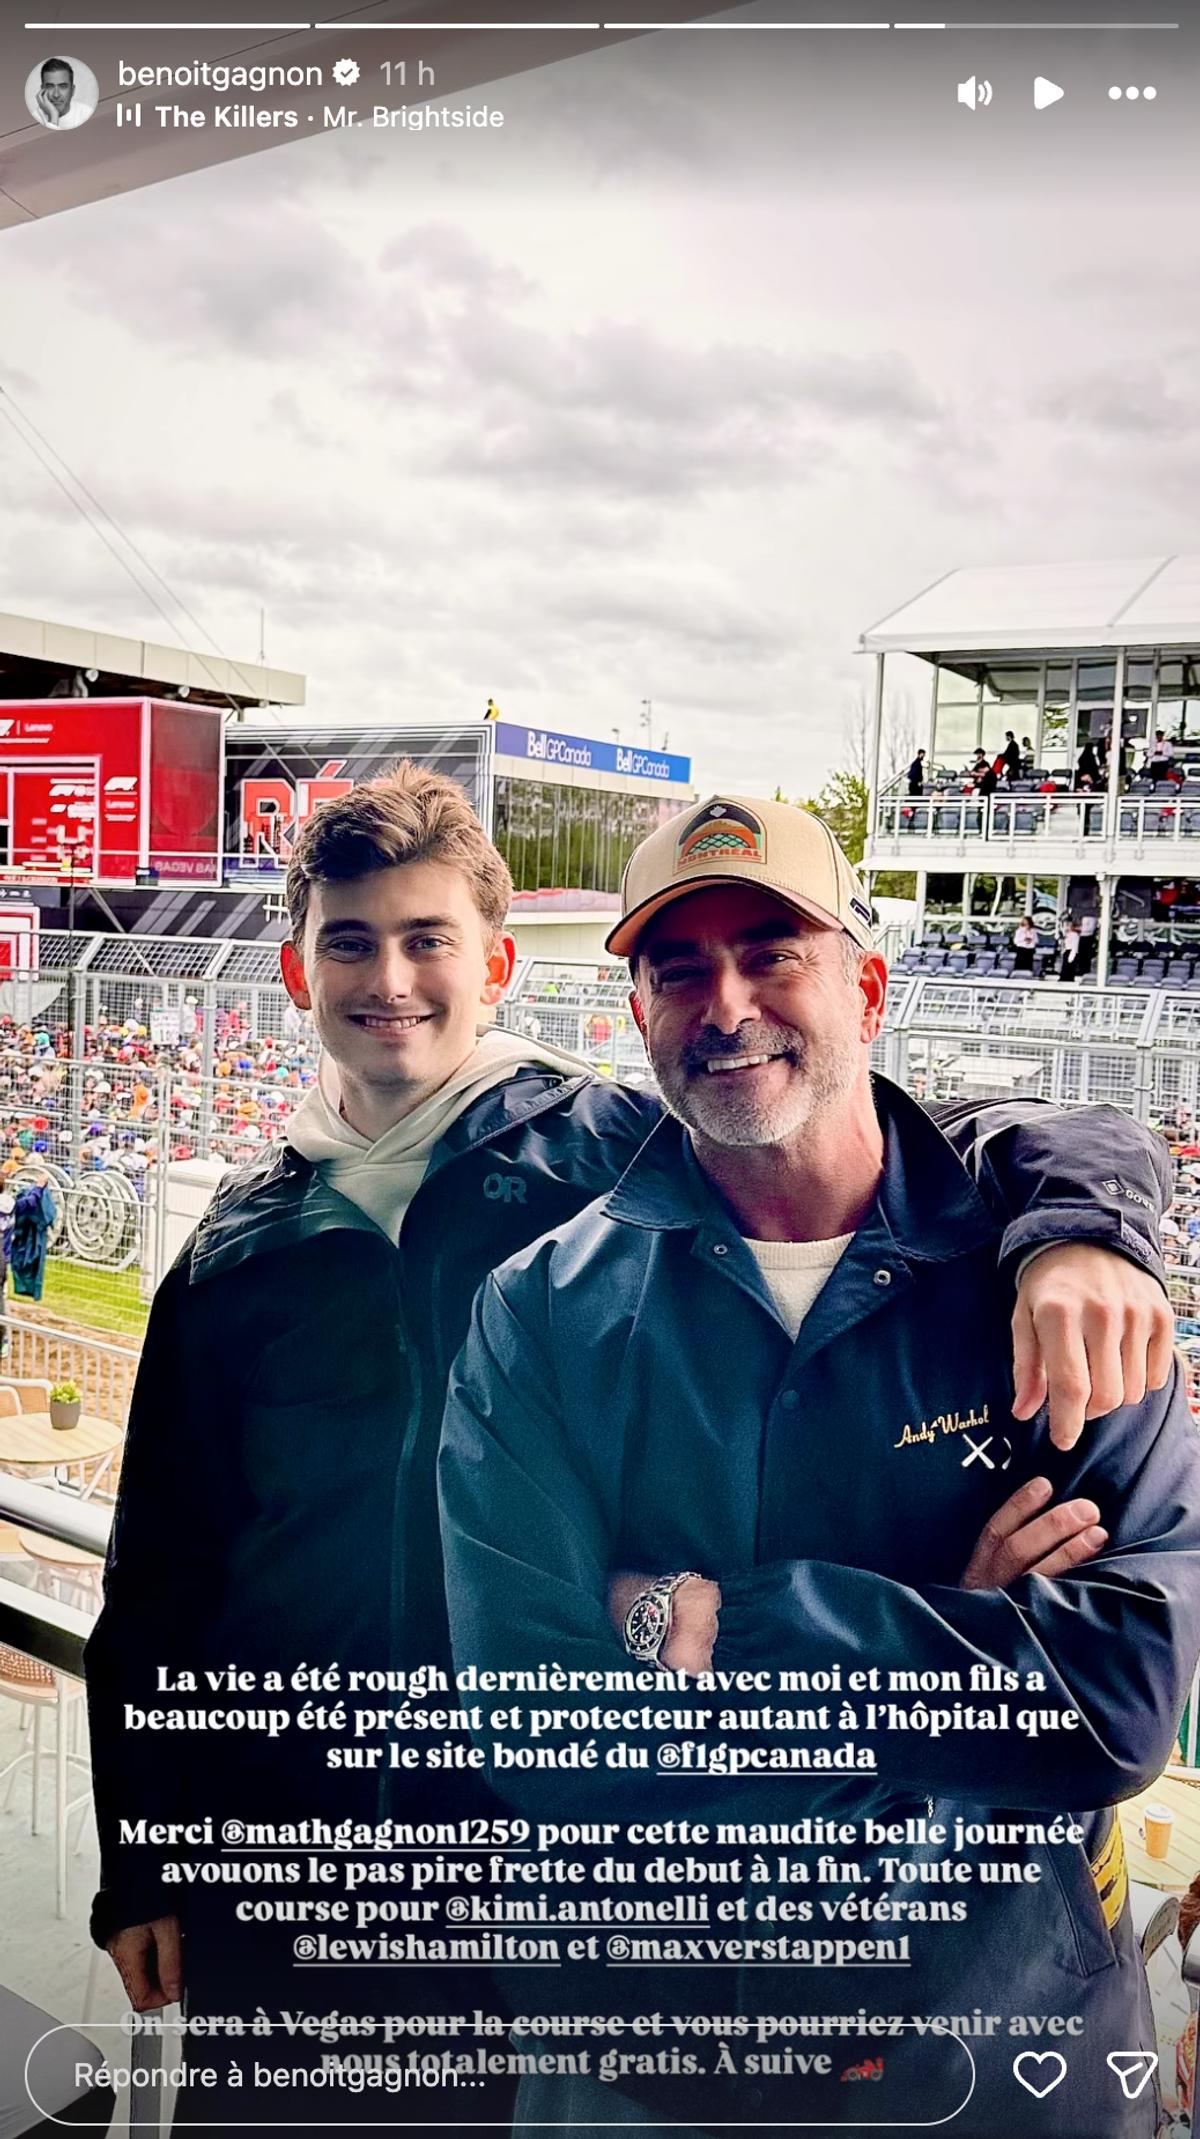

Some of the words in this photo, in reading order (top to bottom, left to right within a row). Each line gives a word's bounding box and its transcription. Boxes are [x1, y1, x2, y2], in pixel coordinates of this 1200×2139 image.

[482, 1172, 529, 1204] OR
[893, 1423, 936, 1448] Andy
[936, 1404, 990, 1434] Warhol
